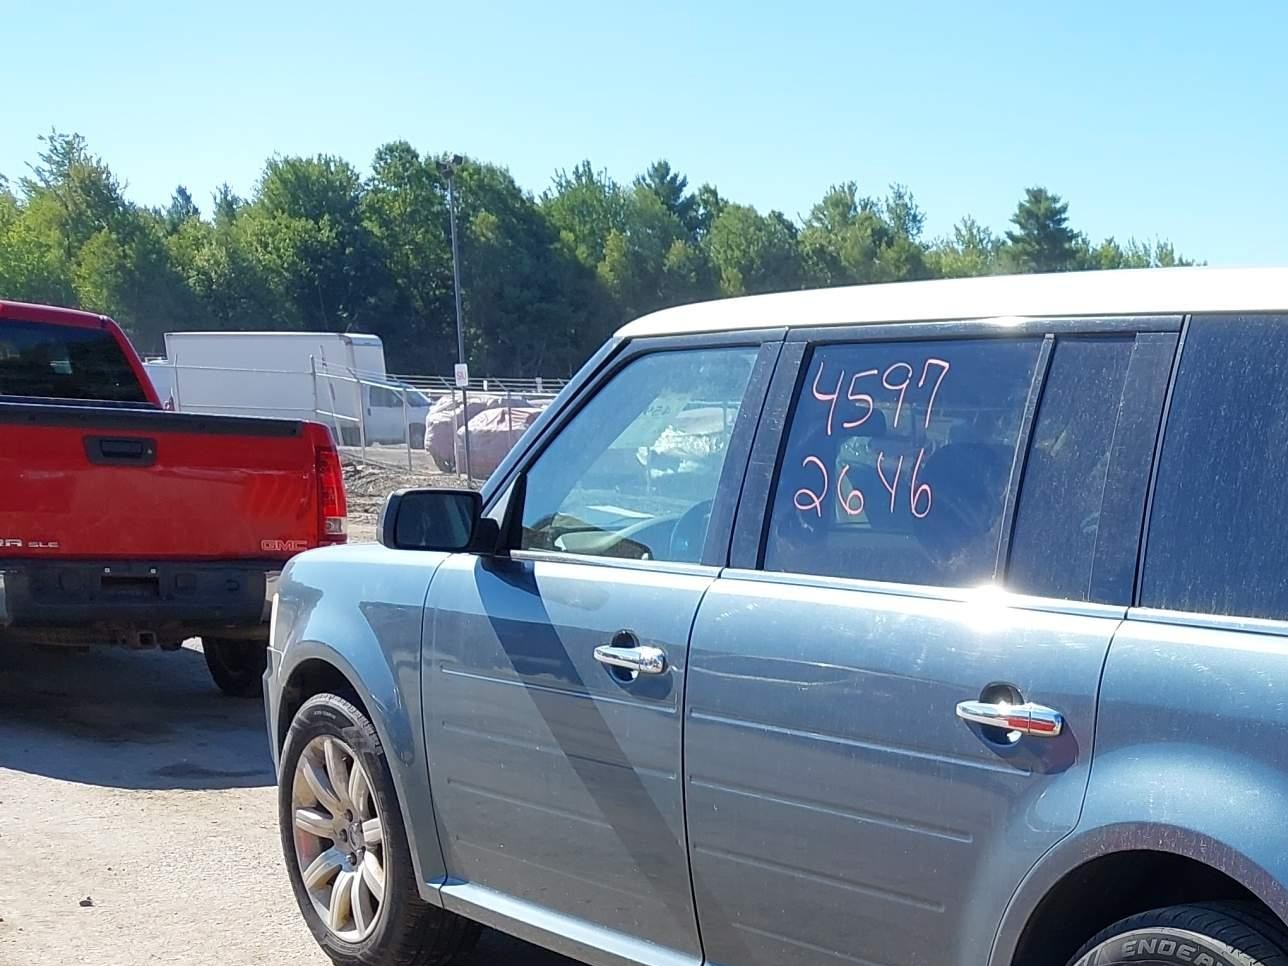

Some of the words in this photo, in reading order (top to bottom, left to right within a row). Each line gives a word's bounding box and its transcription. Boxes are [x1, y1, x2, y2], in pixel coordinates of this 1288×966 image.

[812, 359, 950, 435] 4597
[794, 448, 932, 518] 2646
[0, 538, 23, 547] A
[261, 540, 307, 551] GMC
